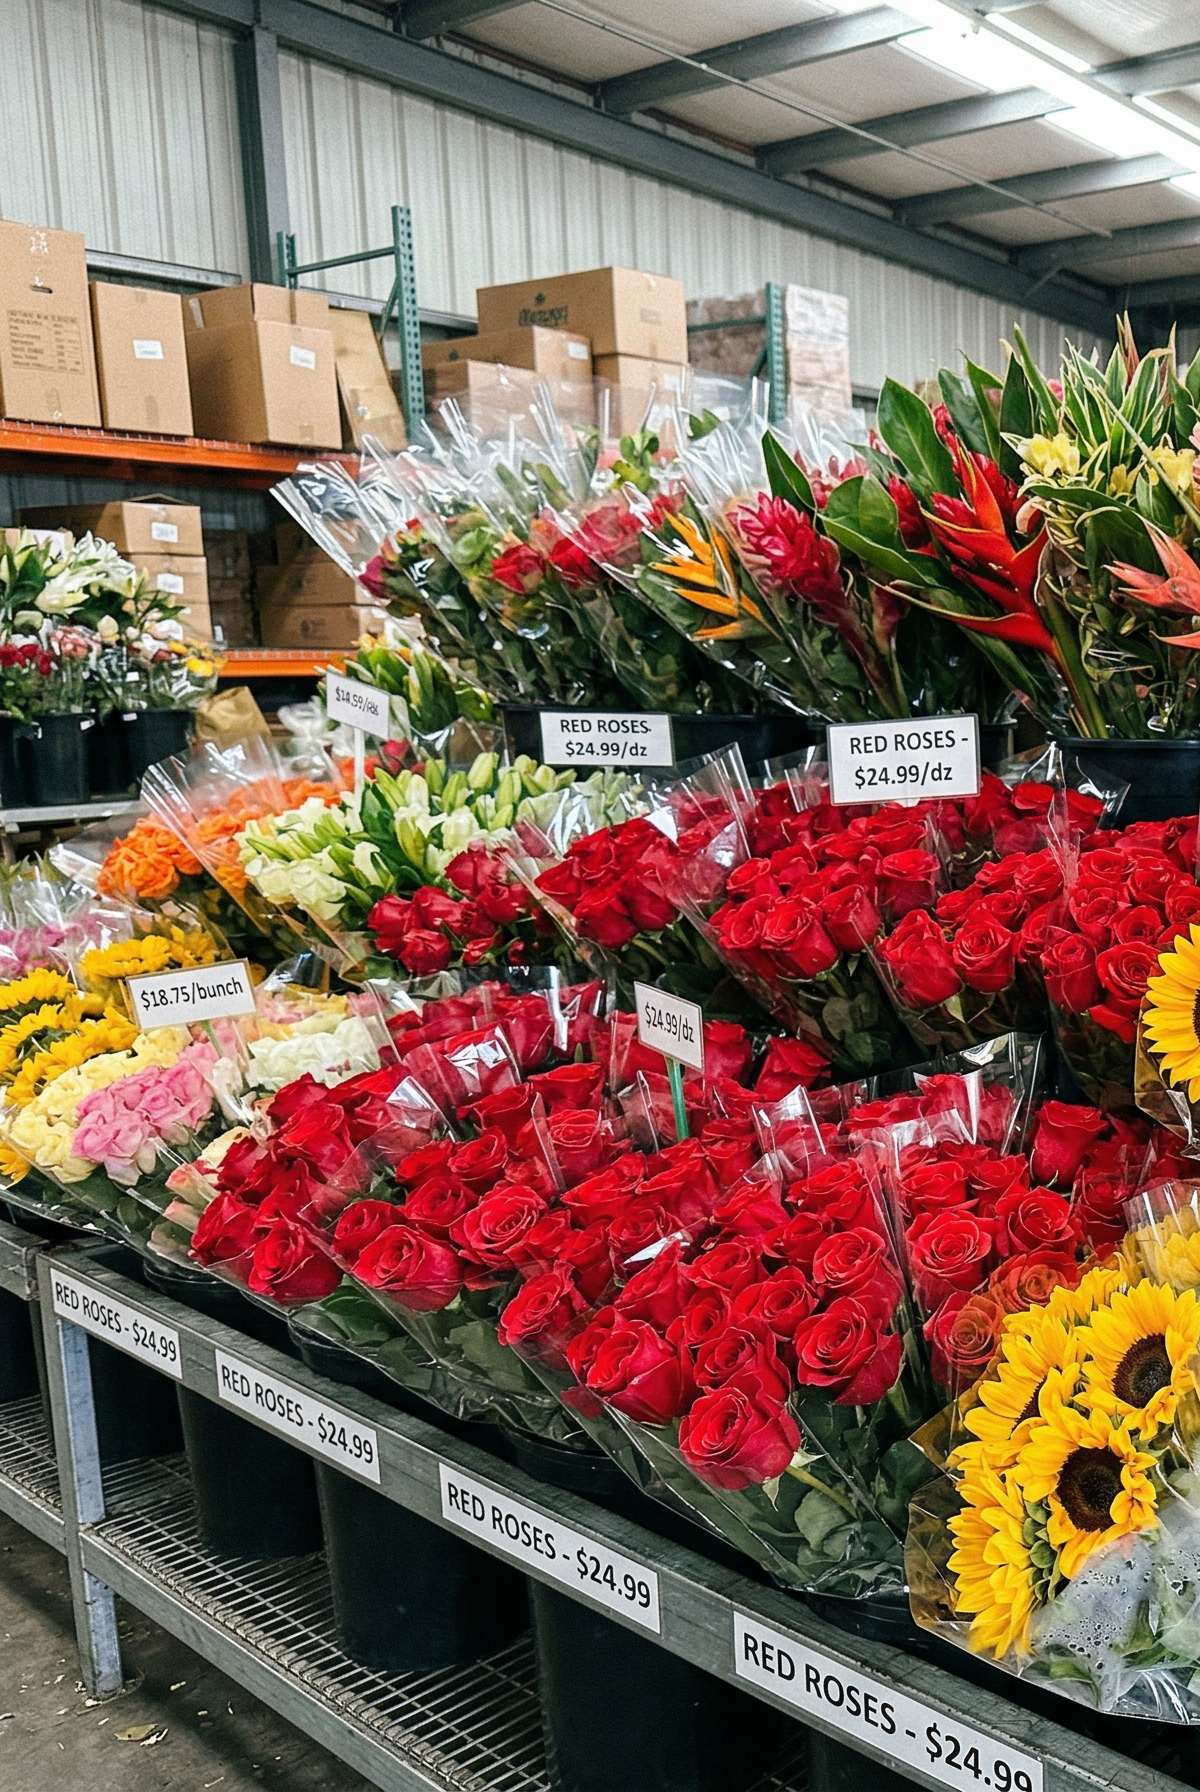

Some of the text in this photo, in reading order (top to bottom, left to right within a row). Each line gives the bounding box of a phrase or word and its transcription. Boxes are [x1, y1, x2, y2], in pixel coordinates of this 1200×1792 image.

[561, 719, 592, 733] RED
[850, 736, 887, 754] RED
[894, 730, 956, 751] ROSES
[565, 740, 647, 759] $24.99/dz
[854, 761, 953, 789] $24.99/dz
[140, 977, 243, 1011] $18.75/bunch
[645, 1002, 694, 1043] $24.99/dz
[56, 1281, 79, 1310] RED
[83, 1295, 122, 1333] ROSES
[133, 1319, 177, 1363] $24.99
[222, 1364, 251, 1398] RED
[255, 1382, 304, 1428] ROSES
[318, 1413, 374, 1465] $24.99
[447, 1482, 485, 1522] RED
[491, 1505, 556, 1560] ROSES
[576, 1547, 651, 1609] $24.99
[743, 1632, 796, 1682] RED
[805, 1663, 896, 1736] ROSES
[926, 1722, 1033, 1792] $24.99
